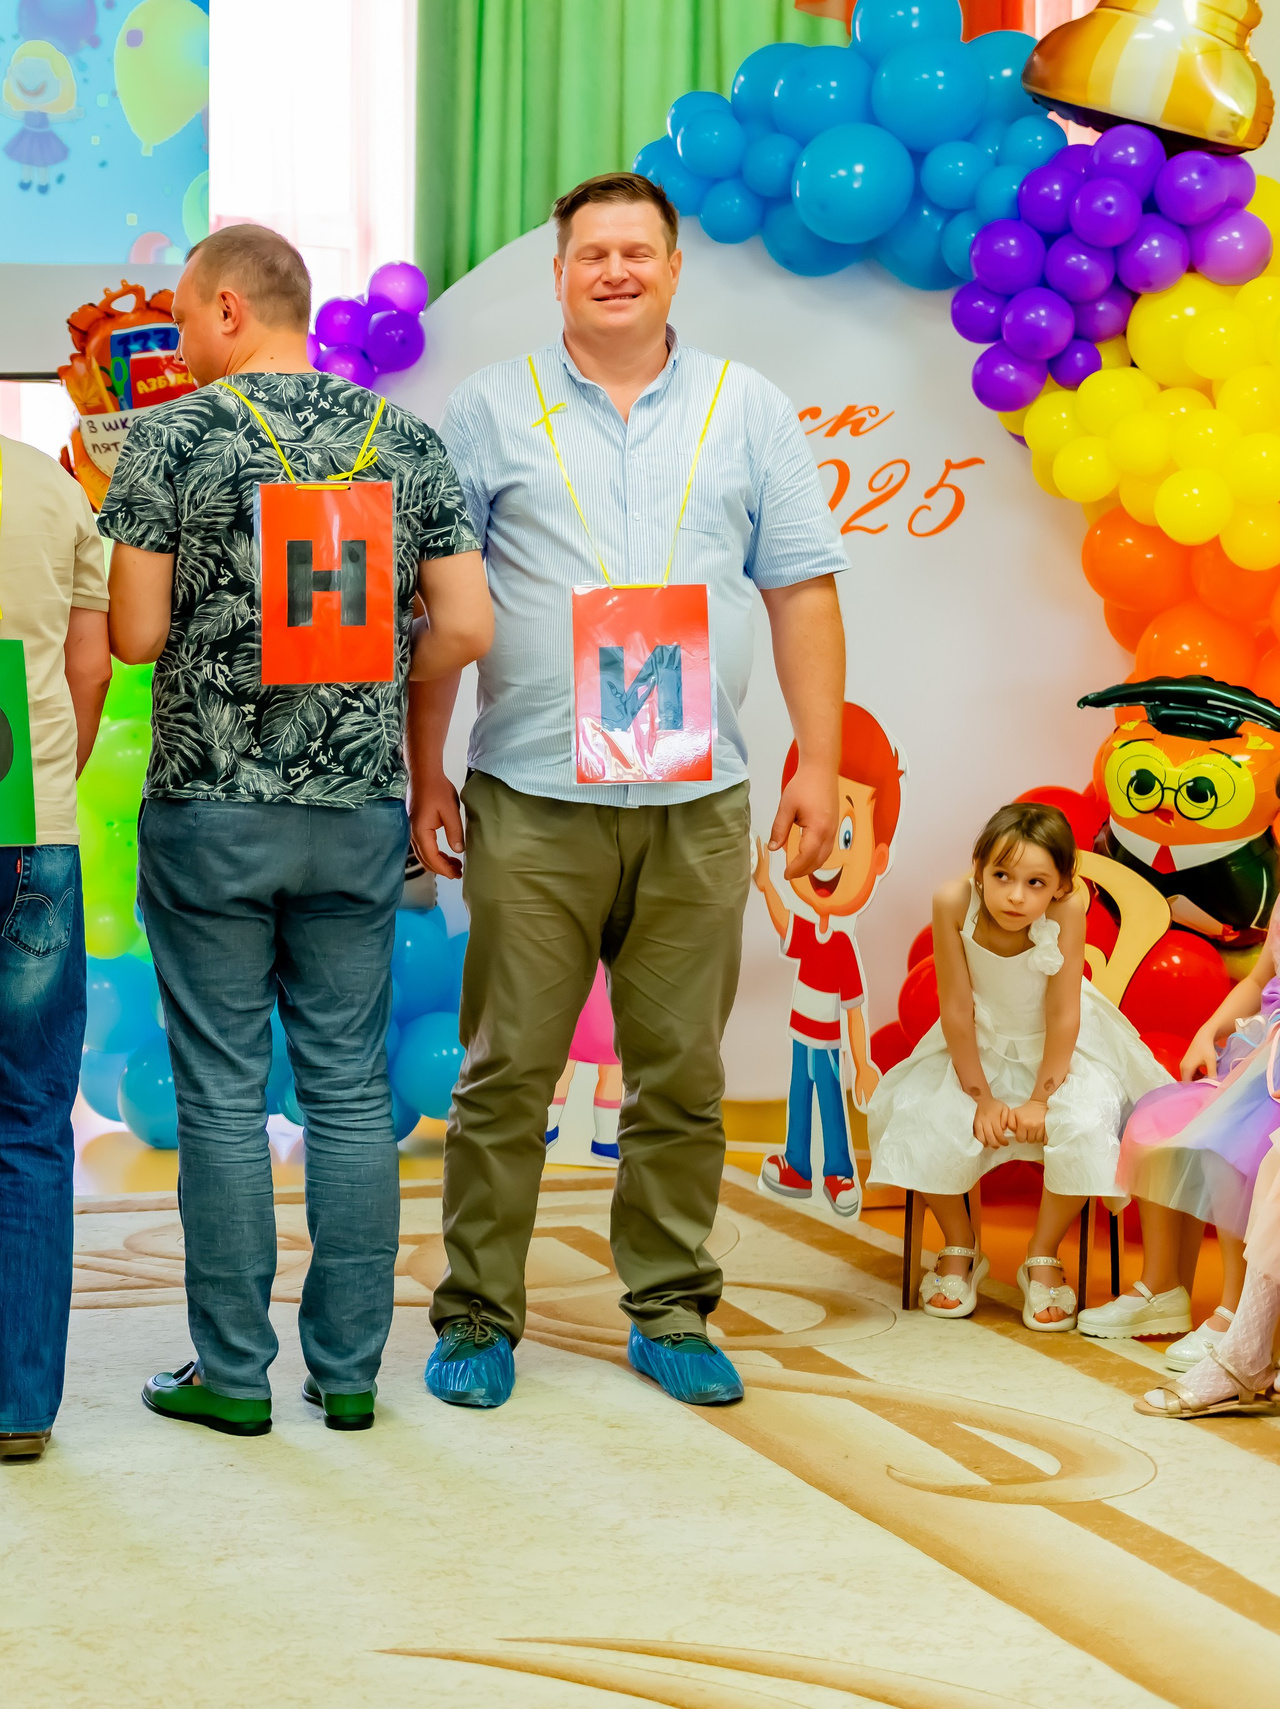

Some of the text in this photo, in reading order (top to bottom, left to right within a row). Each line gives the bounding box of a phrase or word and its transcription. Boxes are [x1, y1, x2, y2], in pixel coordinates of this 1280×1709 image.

[91, 442, 121, 454] пят
[798, 404, 895, 437] ск
[817, 457, 985, 538] 025
[287, 540, 367, 627] Н
[598, 644, 684, 732] И
